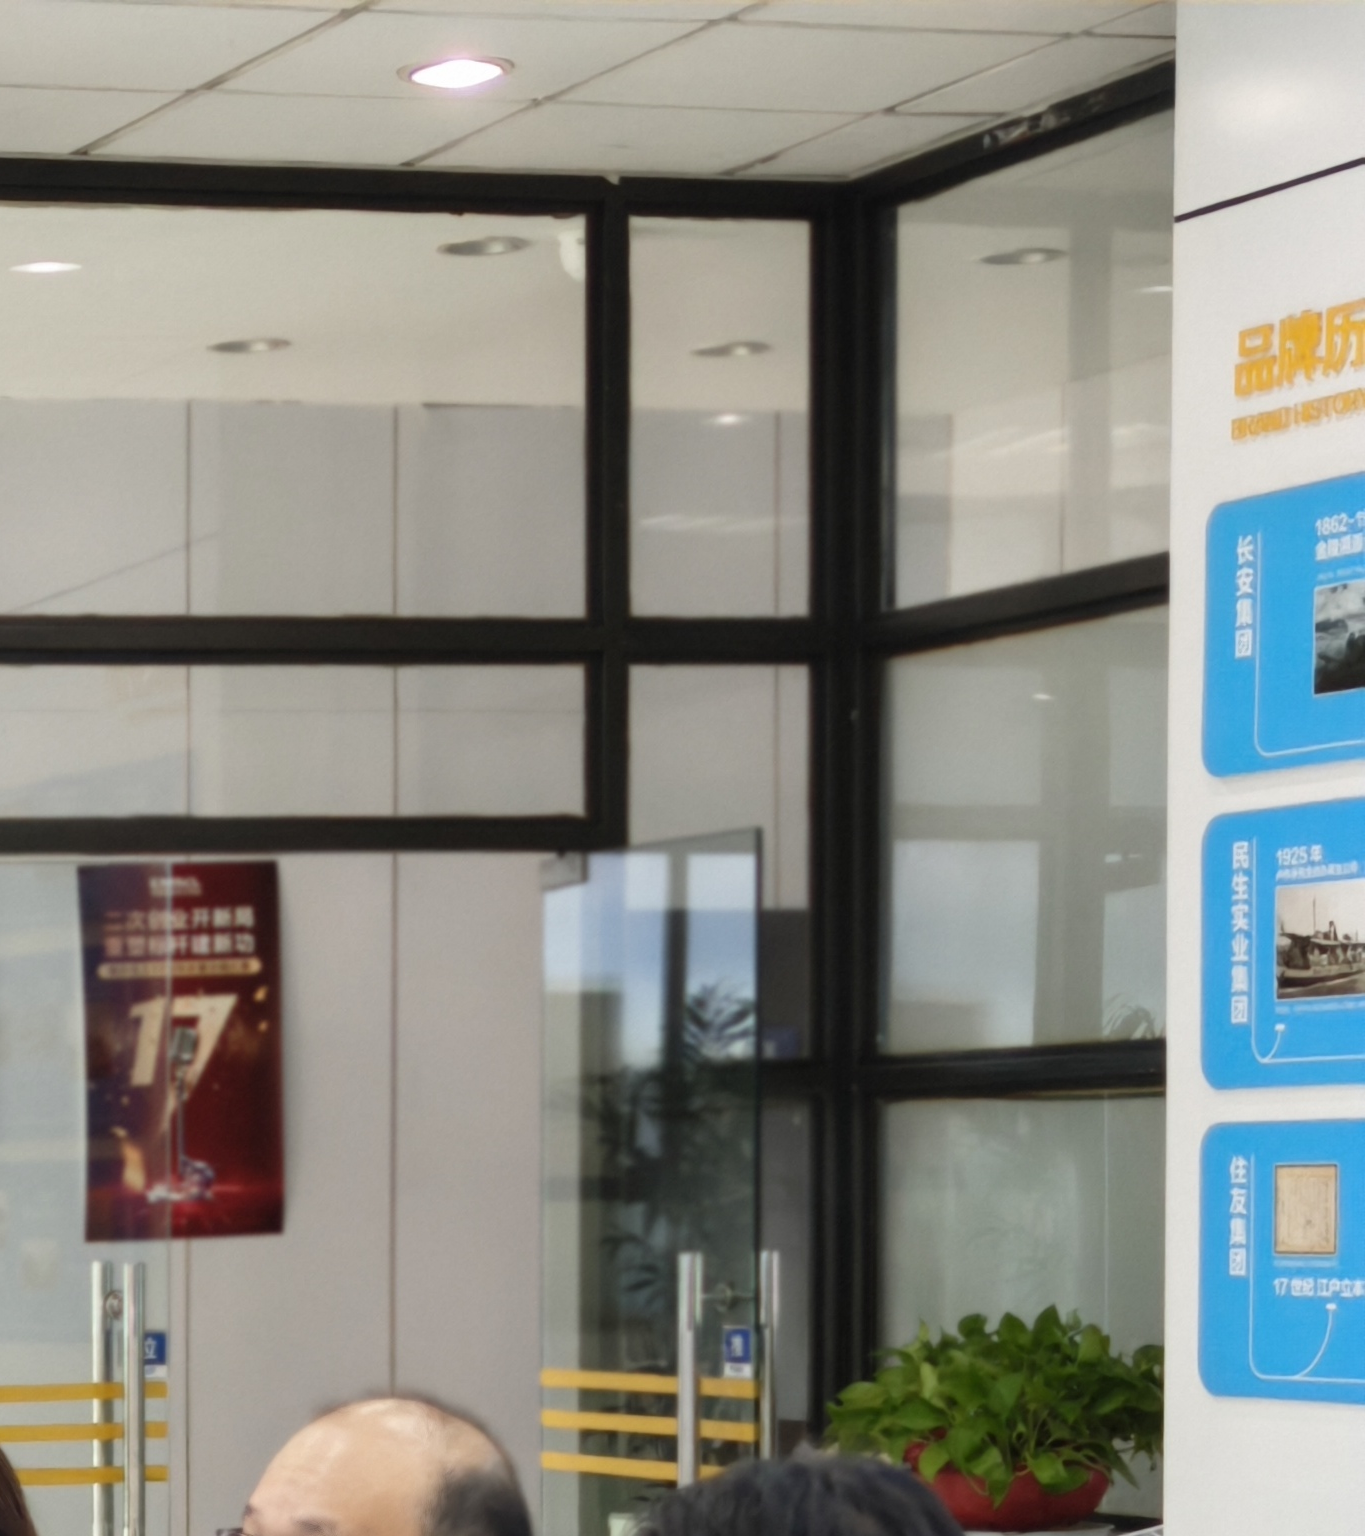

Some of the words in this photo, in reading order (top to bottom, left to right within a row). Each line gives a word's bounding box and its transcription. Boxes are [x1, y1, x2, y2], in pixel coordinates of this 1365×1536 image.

[1235, 535, 1255, 660] 长安集团
[1230, 841, 1250, 1025] 民生实业集团
[130, 994, 238, 1132] 17
[1229, 1155, 1248, 1277] 住友集团
